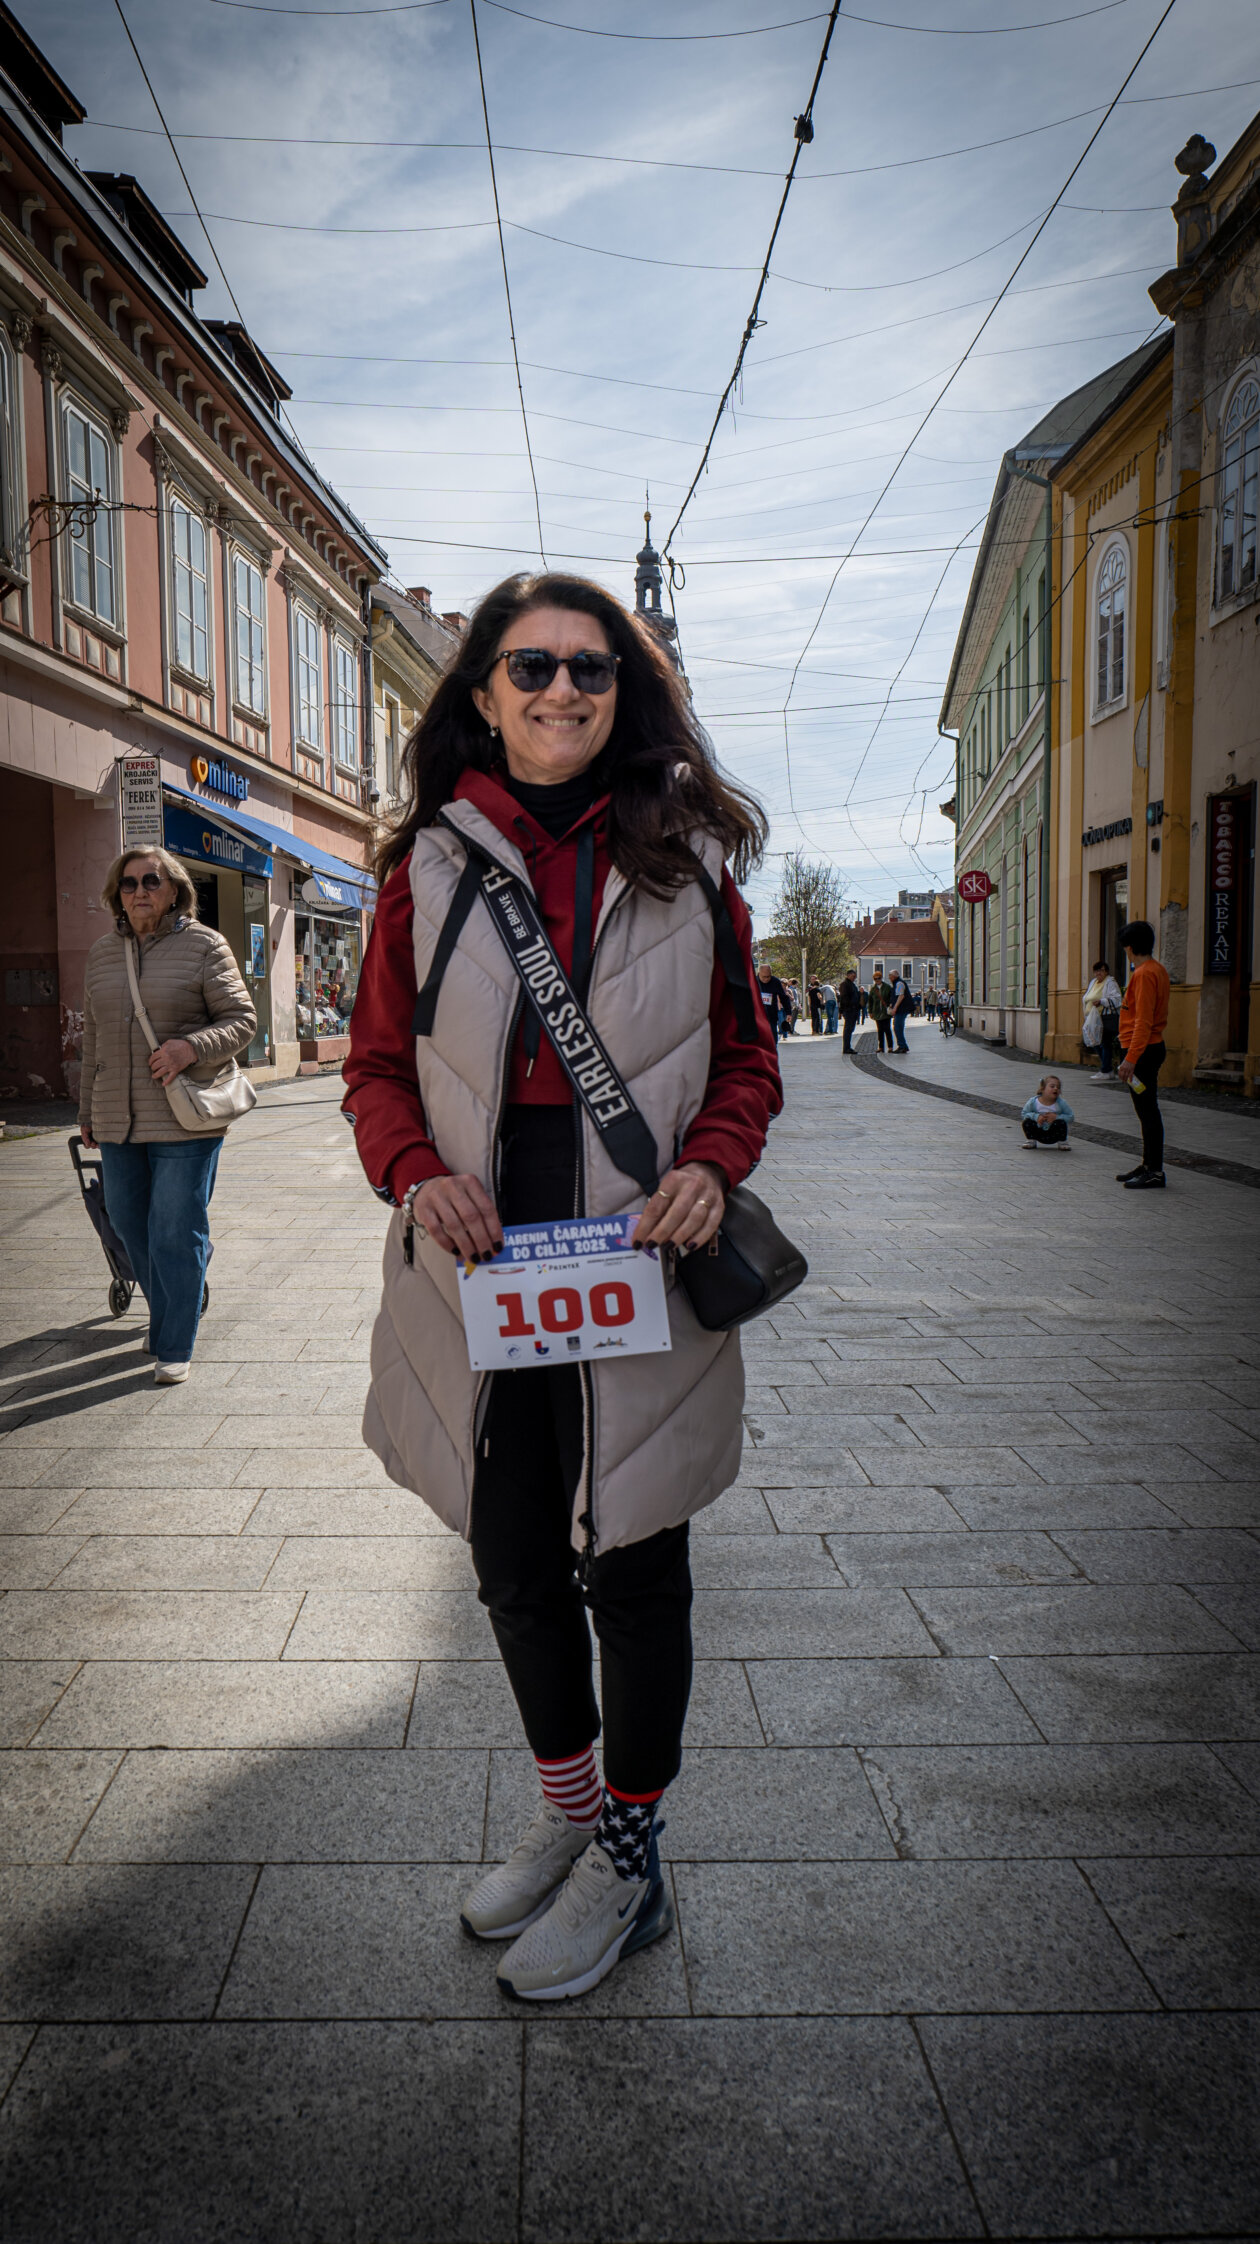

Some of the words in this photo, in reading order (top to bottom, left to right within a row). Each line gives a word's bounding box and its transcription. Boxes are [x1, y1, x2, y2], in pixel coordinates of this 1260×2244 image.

[126, 761, 155, 770] EXPRES
[209, 760, 250, 801] mlinar
[1104, 817, 1132, 840] OPTIKA
[1215, 801, 1234, 889] TOBACCO
[212, 831, 245, 863] mlinar
[499, 893, 521, 927] BRAVE
[1214, 893, 1230, 961] REFAN
[513, 927, 526, 940] BE
[516, 934, 566, 1005] SOUL
[547, 1002, 629, 1128] EARLESS
[553, 1222, 623, 1242] ČARAPAMA
[512, 1246, 530, 1261] DO
[535, 1242, 570, 1258] CILJA
[574, 1238, 610, 1255] 2025.
[496, 1281, 635, 1338] 100
